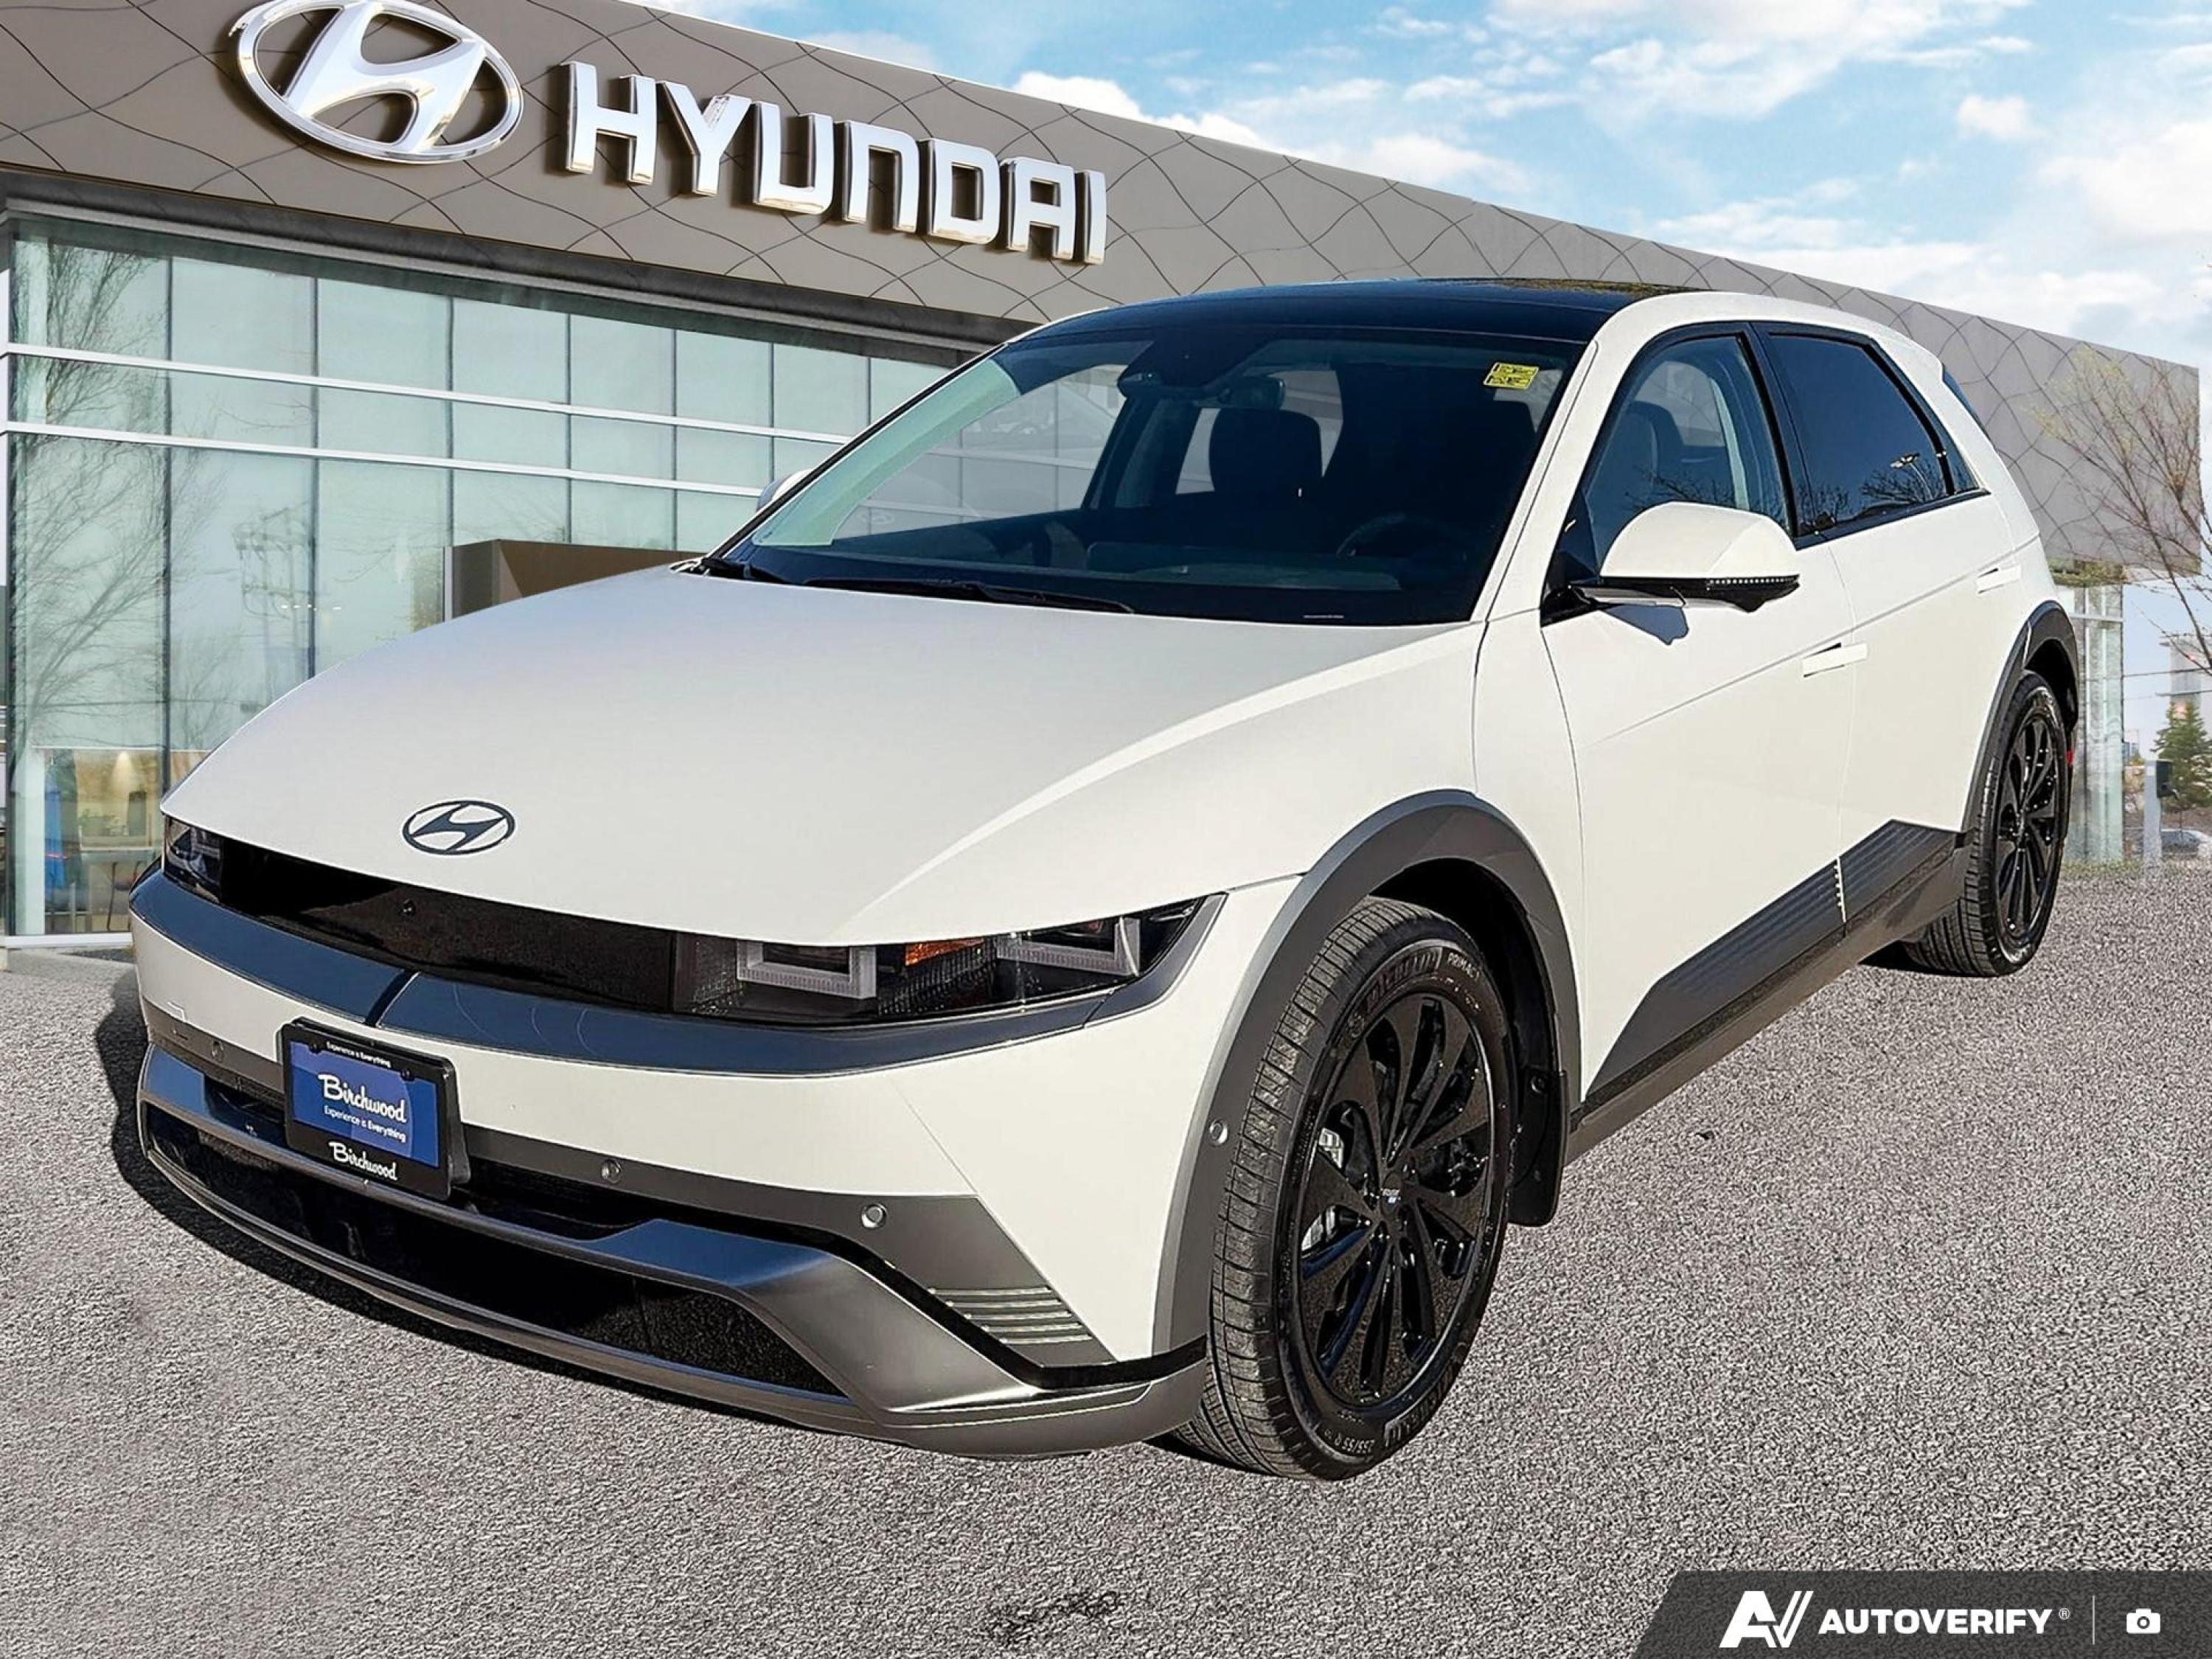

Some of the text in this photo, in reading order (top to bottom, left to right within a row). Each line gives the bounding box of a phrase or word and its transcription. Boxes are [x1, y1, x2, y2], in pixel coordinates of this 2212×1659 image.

[560, 60, 1107, 266] HYUNDAI
[318, 1074, 407, 1123] Birchwood
[324, 1105, 360, 1126] Experience
[368, 1120, 406, 1144] Everything
[329, 1141, 397, 1180] Birchwood
